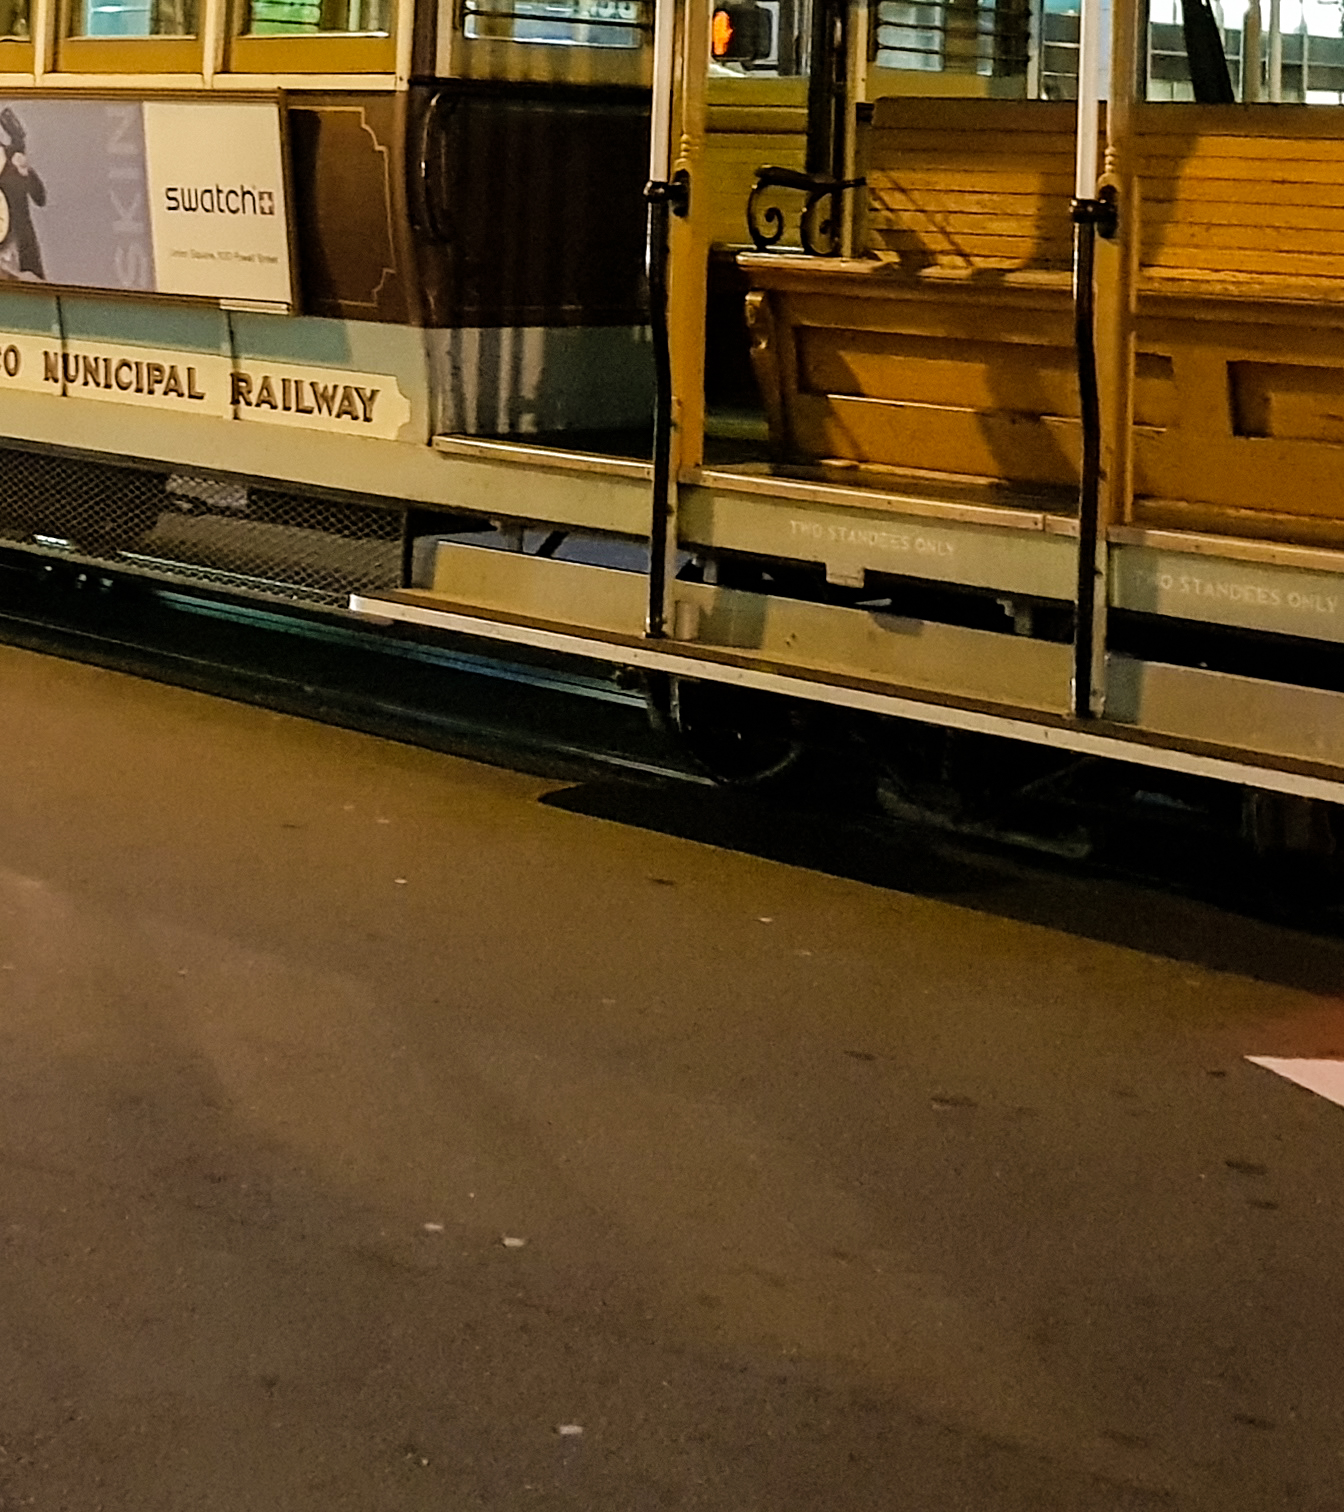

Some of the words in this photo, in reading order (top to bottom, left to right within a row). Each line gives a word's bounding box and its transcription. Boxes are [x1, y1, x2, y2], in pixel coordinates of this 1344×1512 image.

[105, 106, 150, 290] SKIN
[165, 183, 257, 215] swatch
[229, 371, 381, 423] RAILWAY
[828, 526, 909, 550] STANDEES
[914, 536, 955, 557] ONLY
[1181, 576, 1281, 606] STANDEES
[1287, 591, 1339, 614] ONLY
